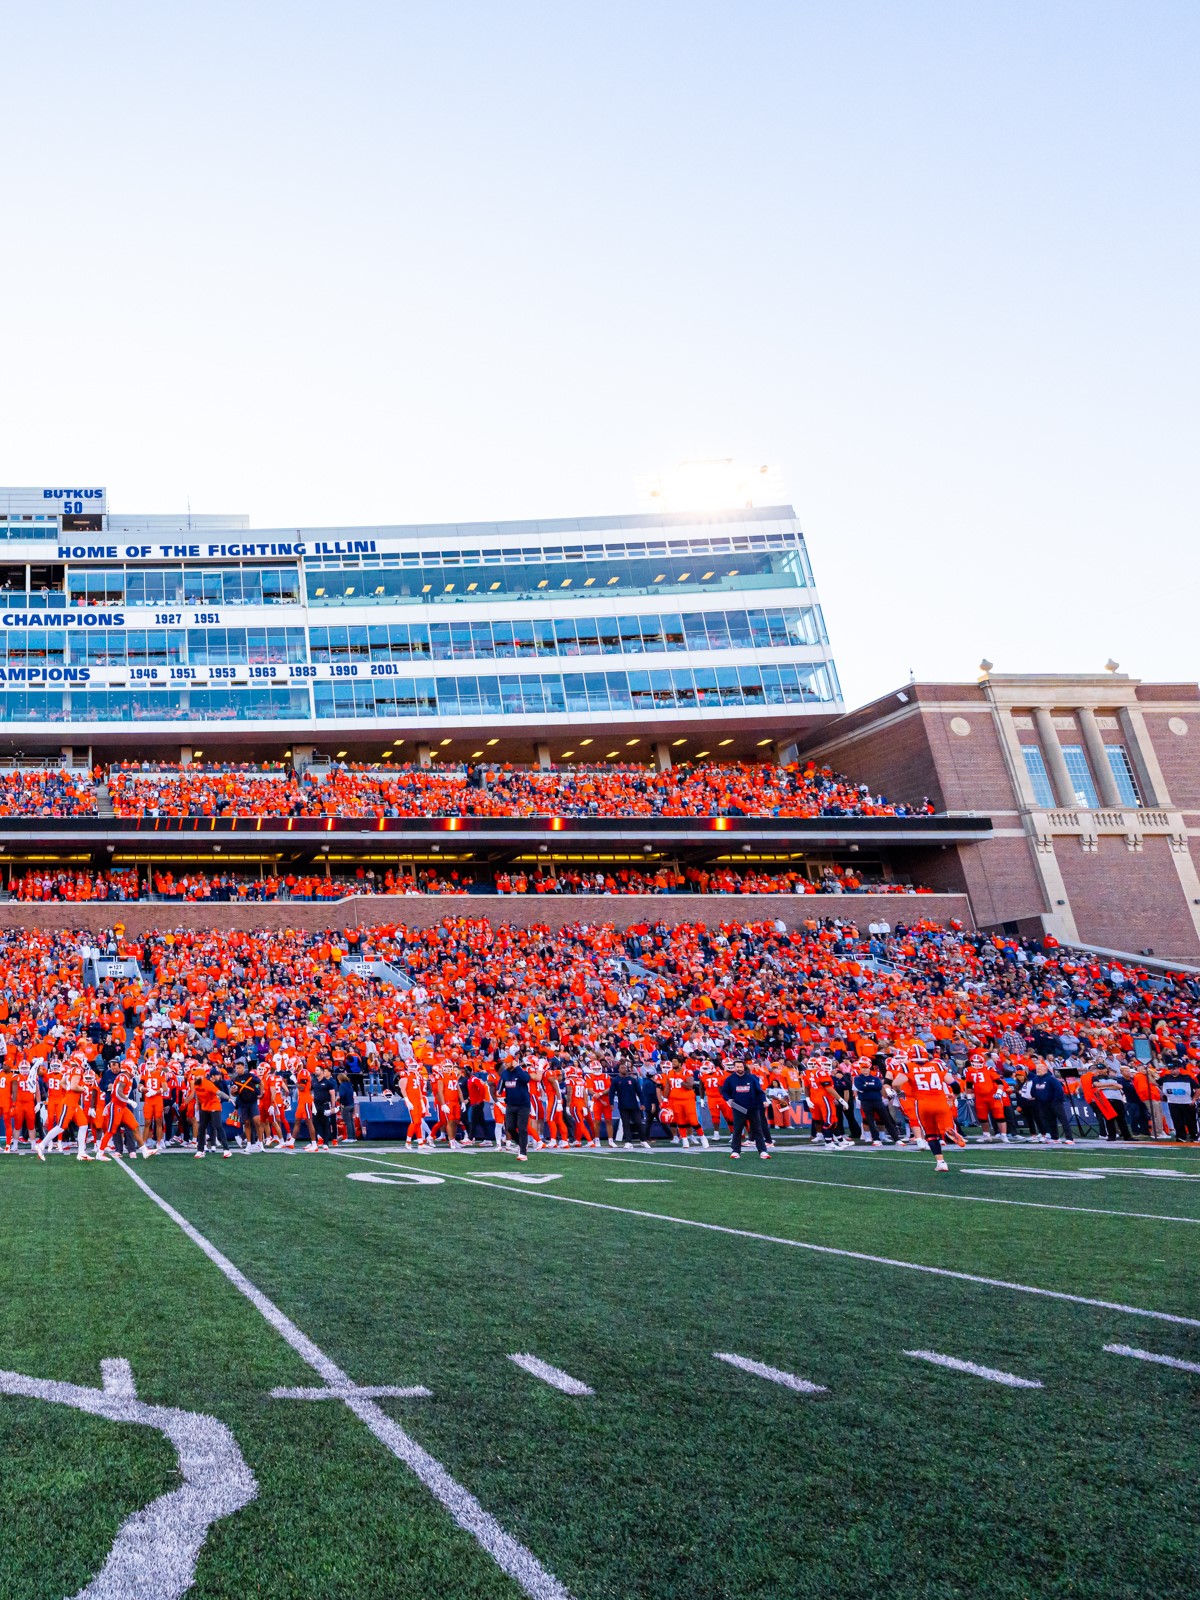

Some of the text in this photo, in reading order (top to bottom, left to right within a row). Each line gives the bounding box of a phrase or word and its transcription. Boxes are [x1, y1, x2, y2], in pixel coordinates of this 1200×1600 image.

[43, 489, 103, 499] BUTKUS
[63, 501, 83, 514] 50
[57, 540, 377, 558] HOME OF THE FIGHTING ILLINI
[2, 613, 125, 627] CHAMPIONS
[155, 612, 220, 625] 1927 1951
[130, 663, 399, 679] 1946 1951 1953 1963 1983 1990 2001
[971, 1072, 985, 1083] 73
